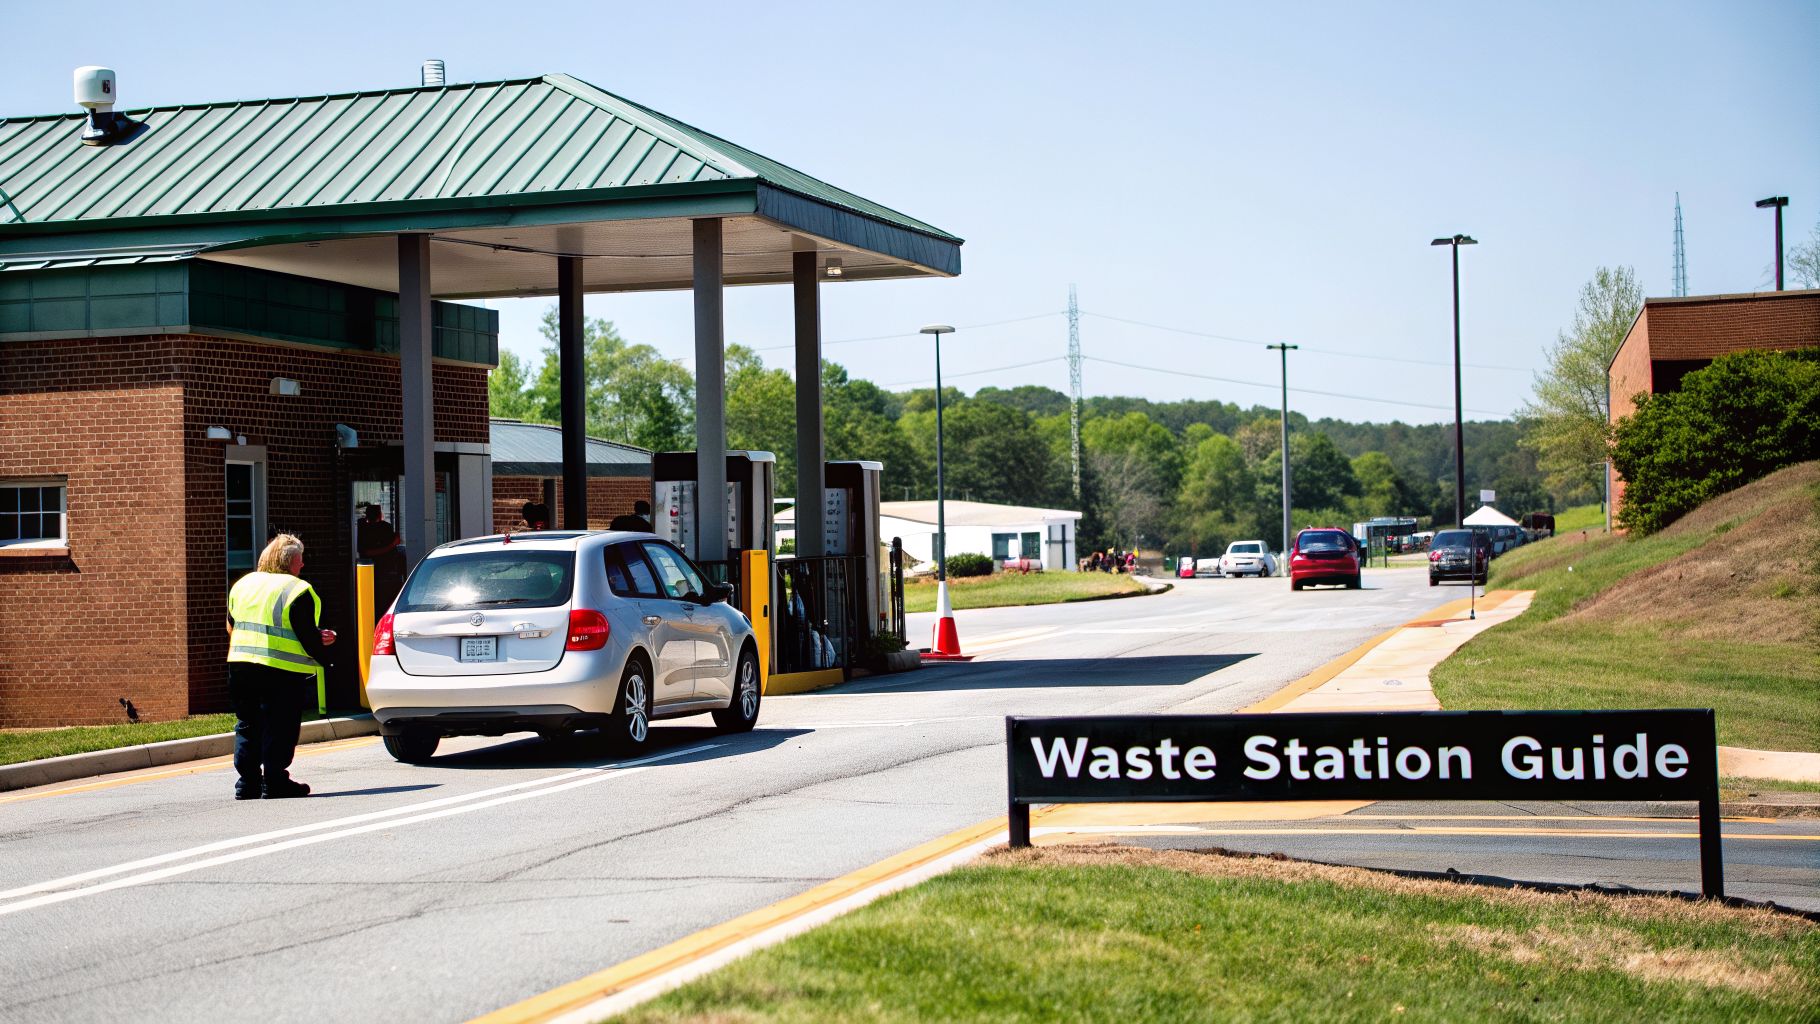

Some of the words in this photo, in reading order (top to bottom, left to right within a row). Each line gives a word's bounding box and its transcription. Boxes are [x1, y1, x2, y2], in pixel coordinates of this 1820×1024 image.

[1030, 736, 1217, 780] Waste
[1243, 734, 1472, 780] Station
[1501, 732, 1689, 780] Guide
